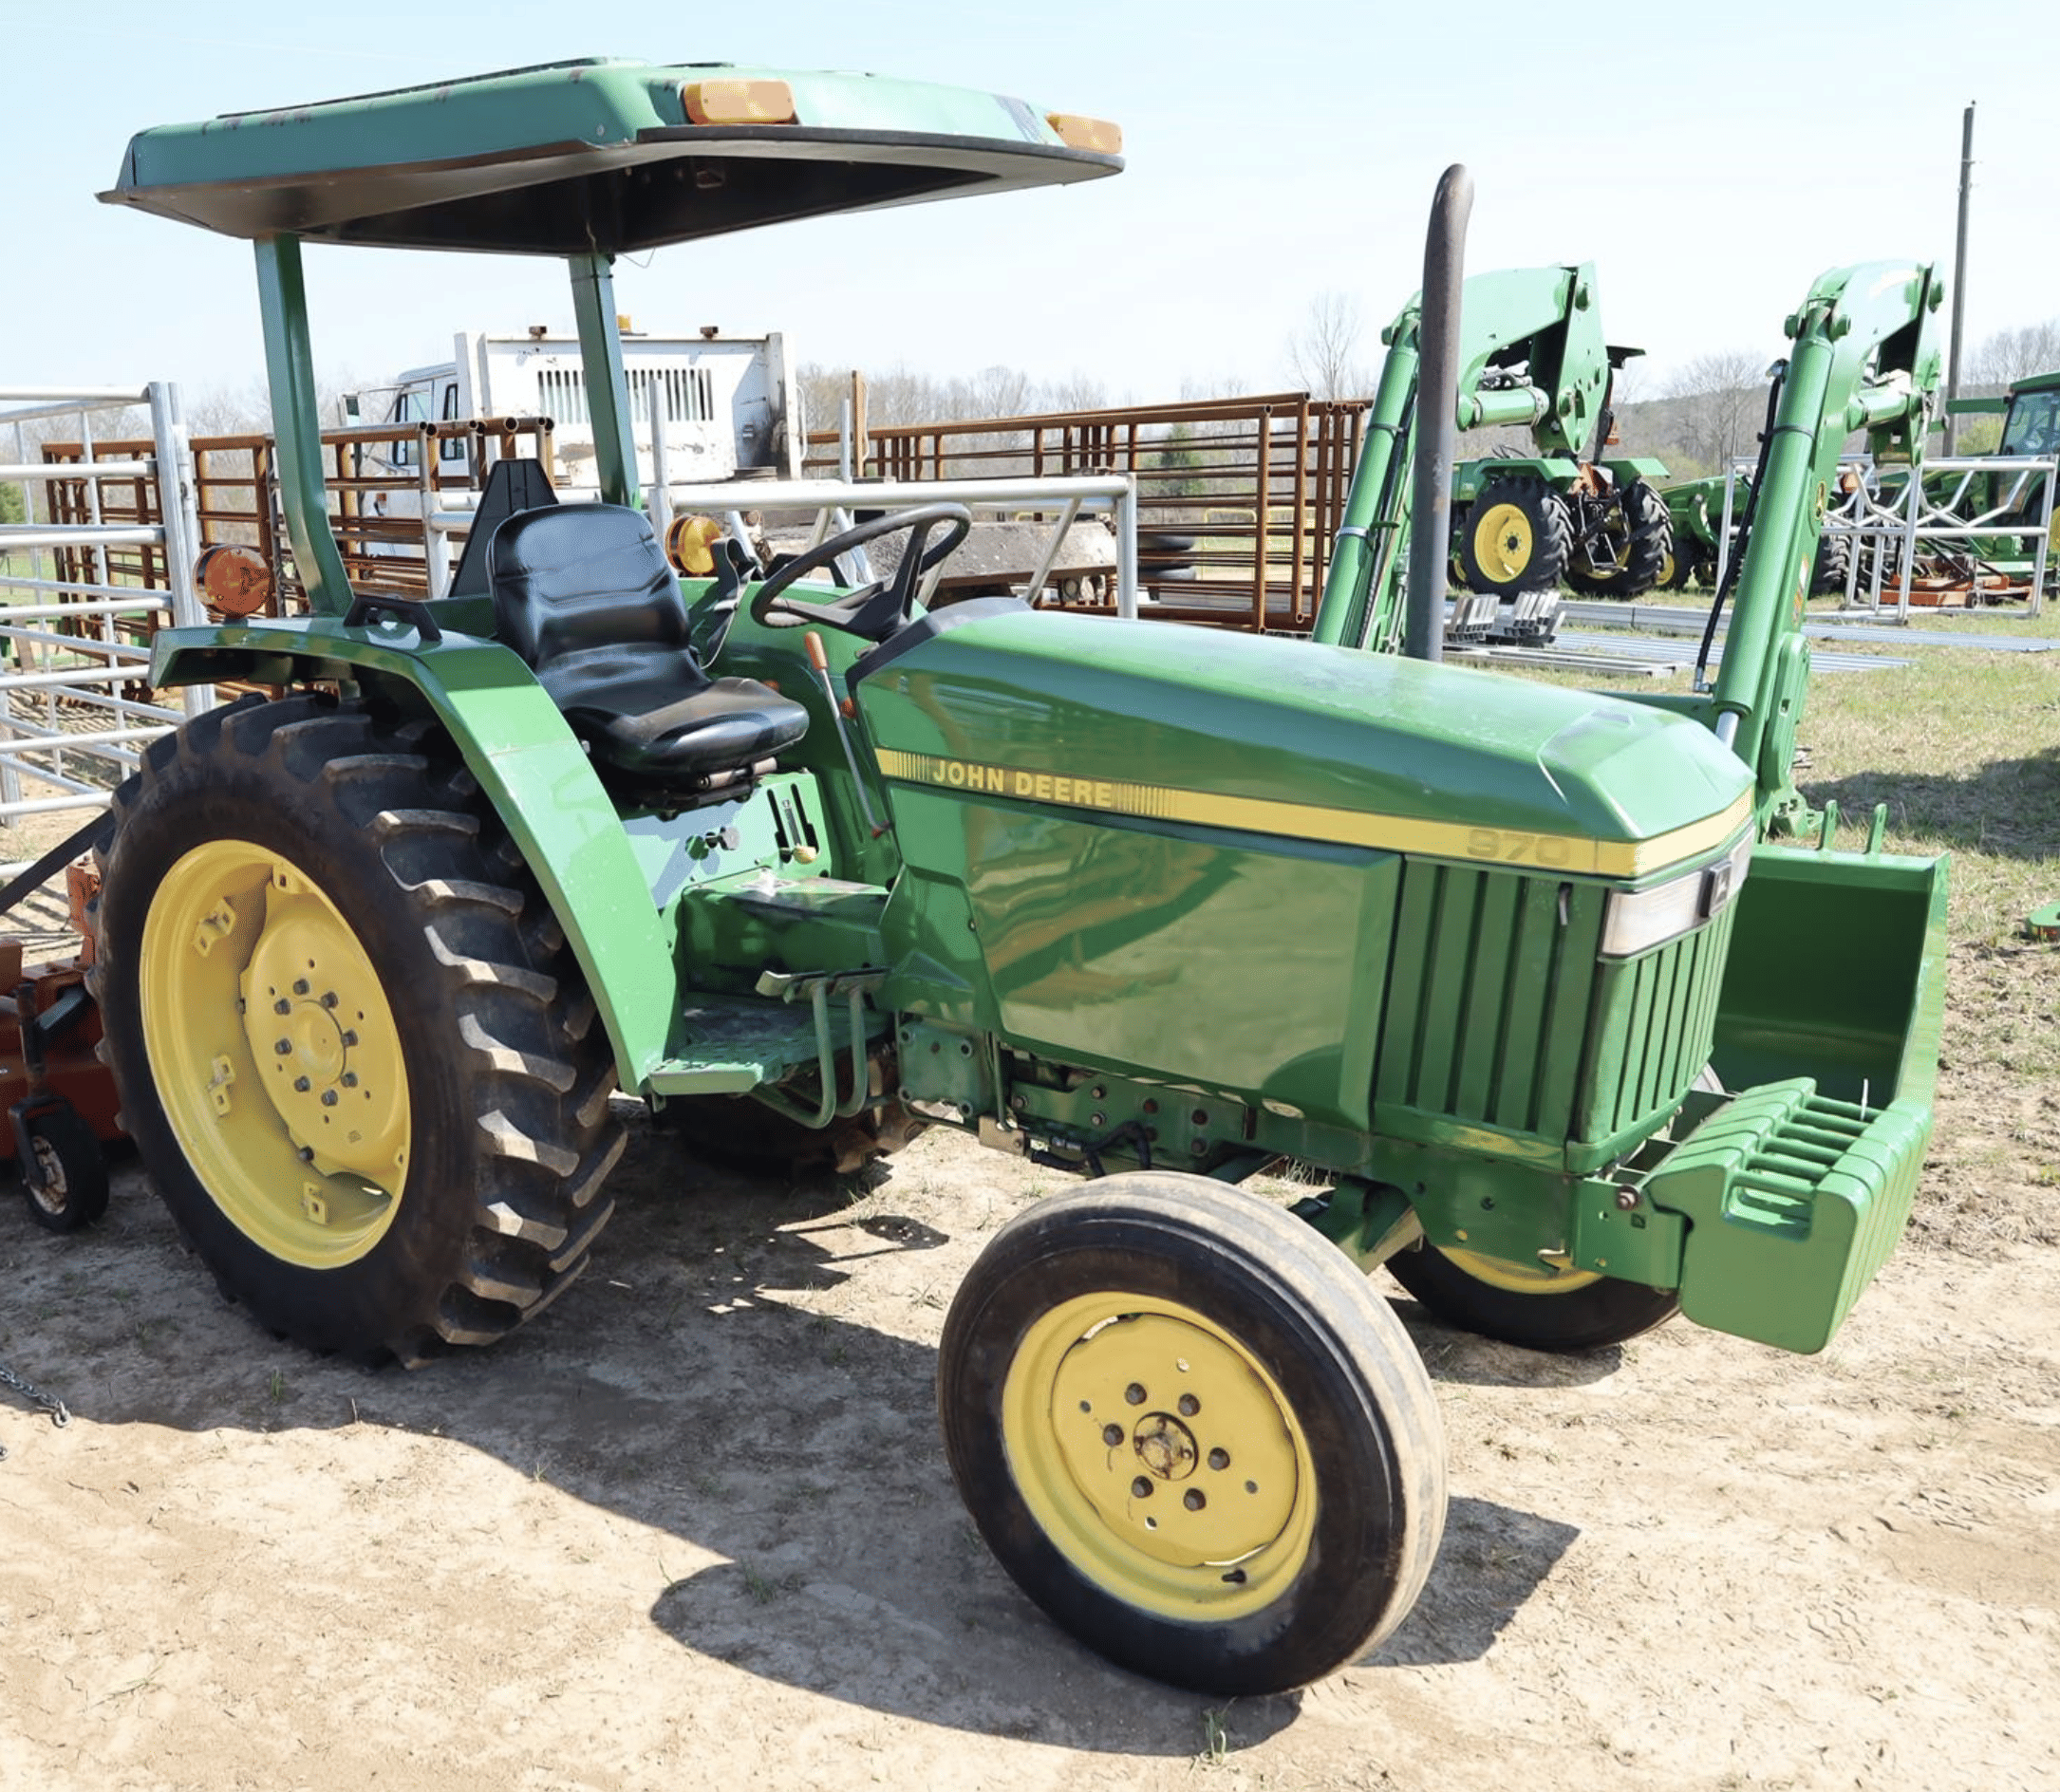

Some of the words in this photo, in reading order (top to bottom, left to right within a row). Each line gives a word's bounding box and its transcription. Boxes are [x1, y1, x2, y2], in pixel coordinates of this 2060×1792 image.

[933, 760, 1003, 792] JOHN
[1015, 772, 1112, 808] DEERE
[1467, 829, 1570, 867] 970
